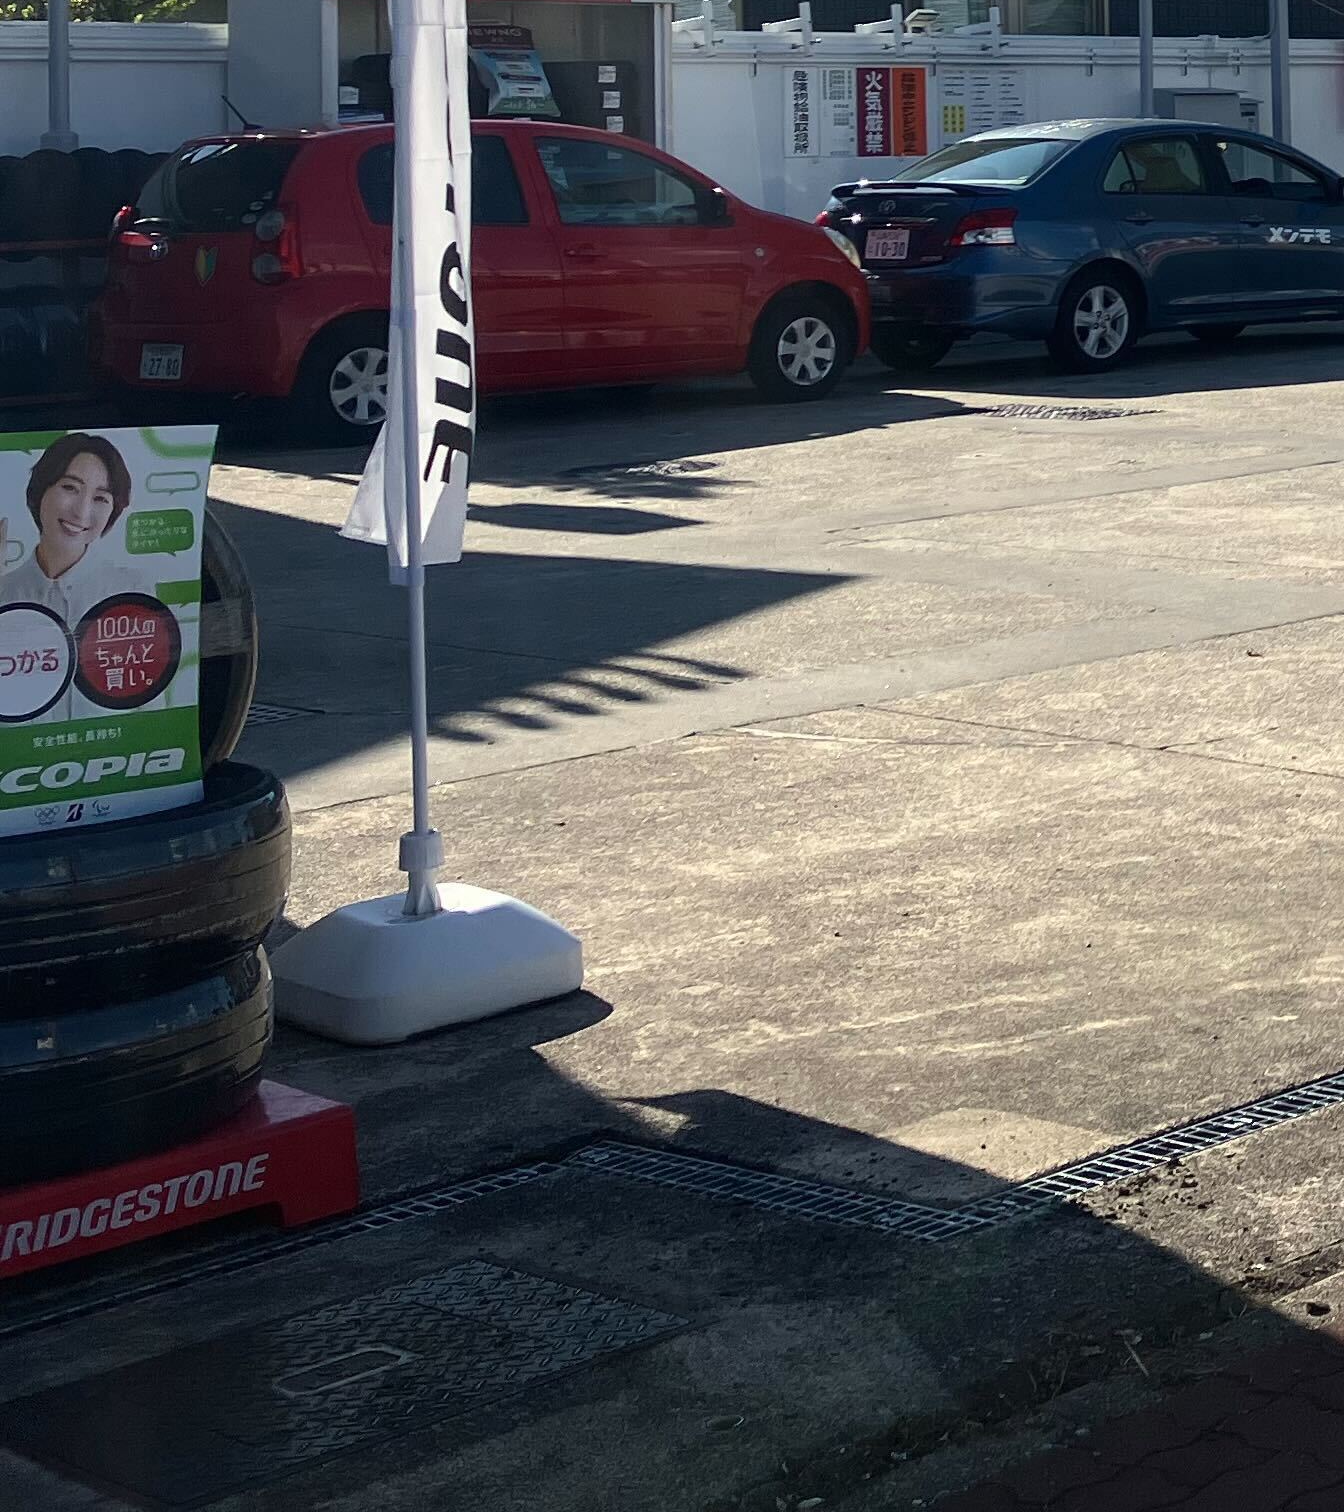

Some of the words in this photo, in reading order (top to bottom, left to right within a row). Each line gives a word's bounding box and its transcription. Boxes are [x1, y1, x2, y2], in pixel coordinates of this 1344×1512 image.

[864, 70, 884, 154] 火気厳禁
[97, 615, 156, 637] 100人の
[96, 644, 155, 667] ちゃんと
[106, 668, 153, 691] 買い。
[0, 747, 186, 794] COPIA
[0, 1153, 269, 1262] RIDGESTONE
